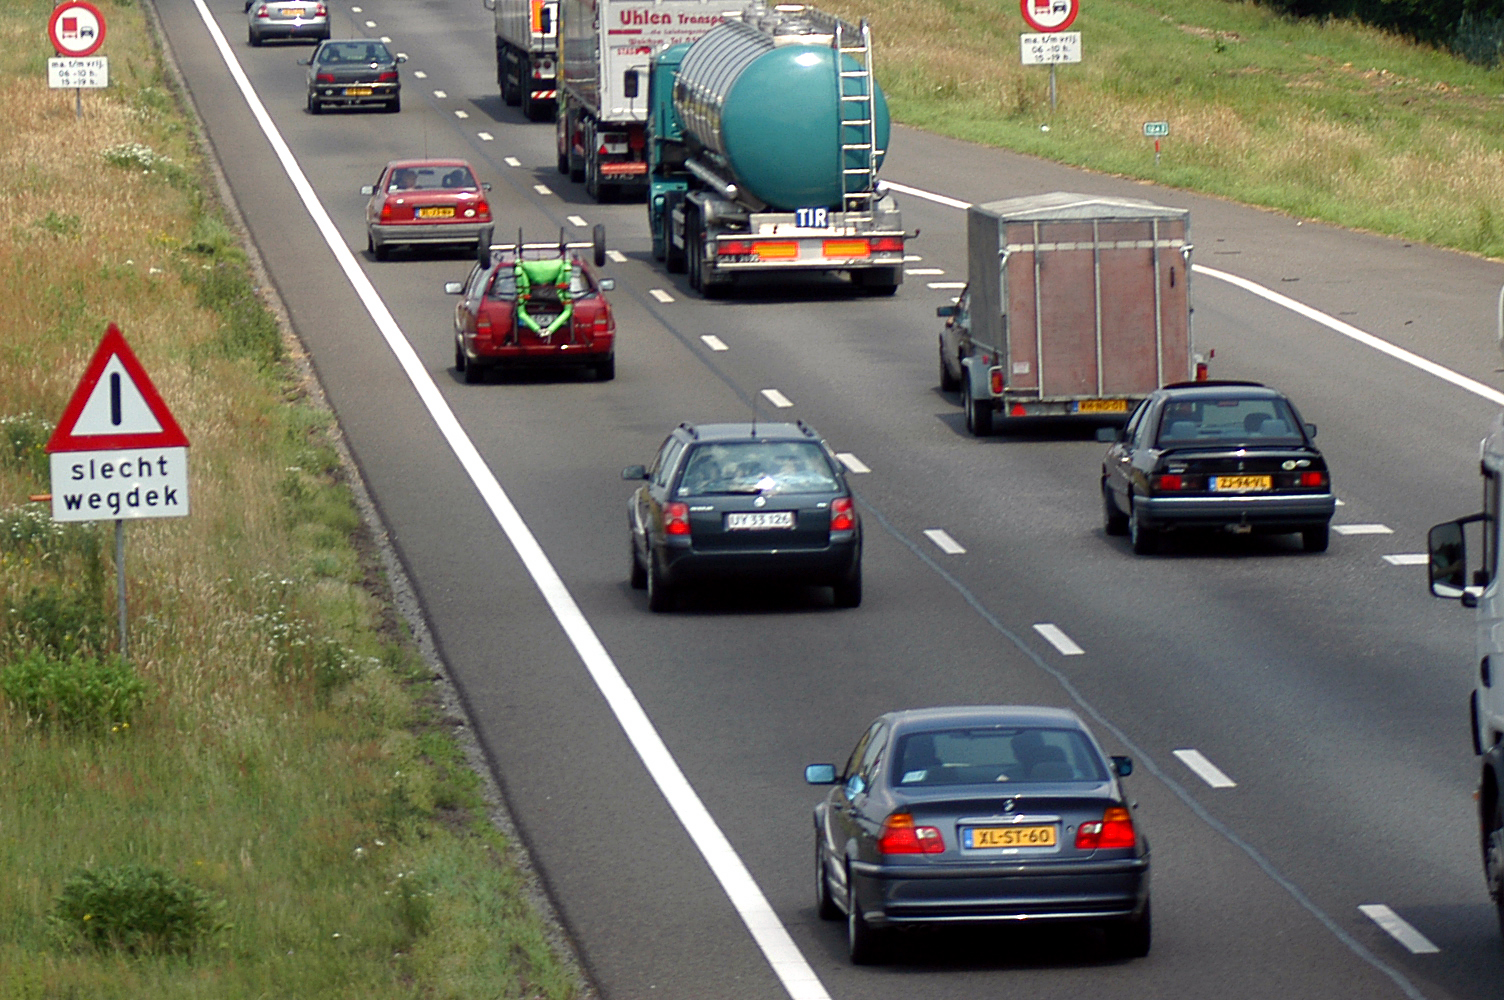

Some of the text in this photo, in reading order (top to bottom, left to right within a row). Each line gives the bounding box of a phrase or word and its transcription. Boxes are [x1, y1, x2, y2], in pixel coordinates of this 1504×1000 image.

[620, 10, 671, 25] Uhlen
[1042, 34, 1057, 43] t/m
[69, 59, 84, 68] t/m
[797, 208, 827, 227] TIR
[71, 455, 168, 480] slecht
[63, 485, 178, 515] wegdek
[979, 829, 1050, 844] XL-ST-60
